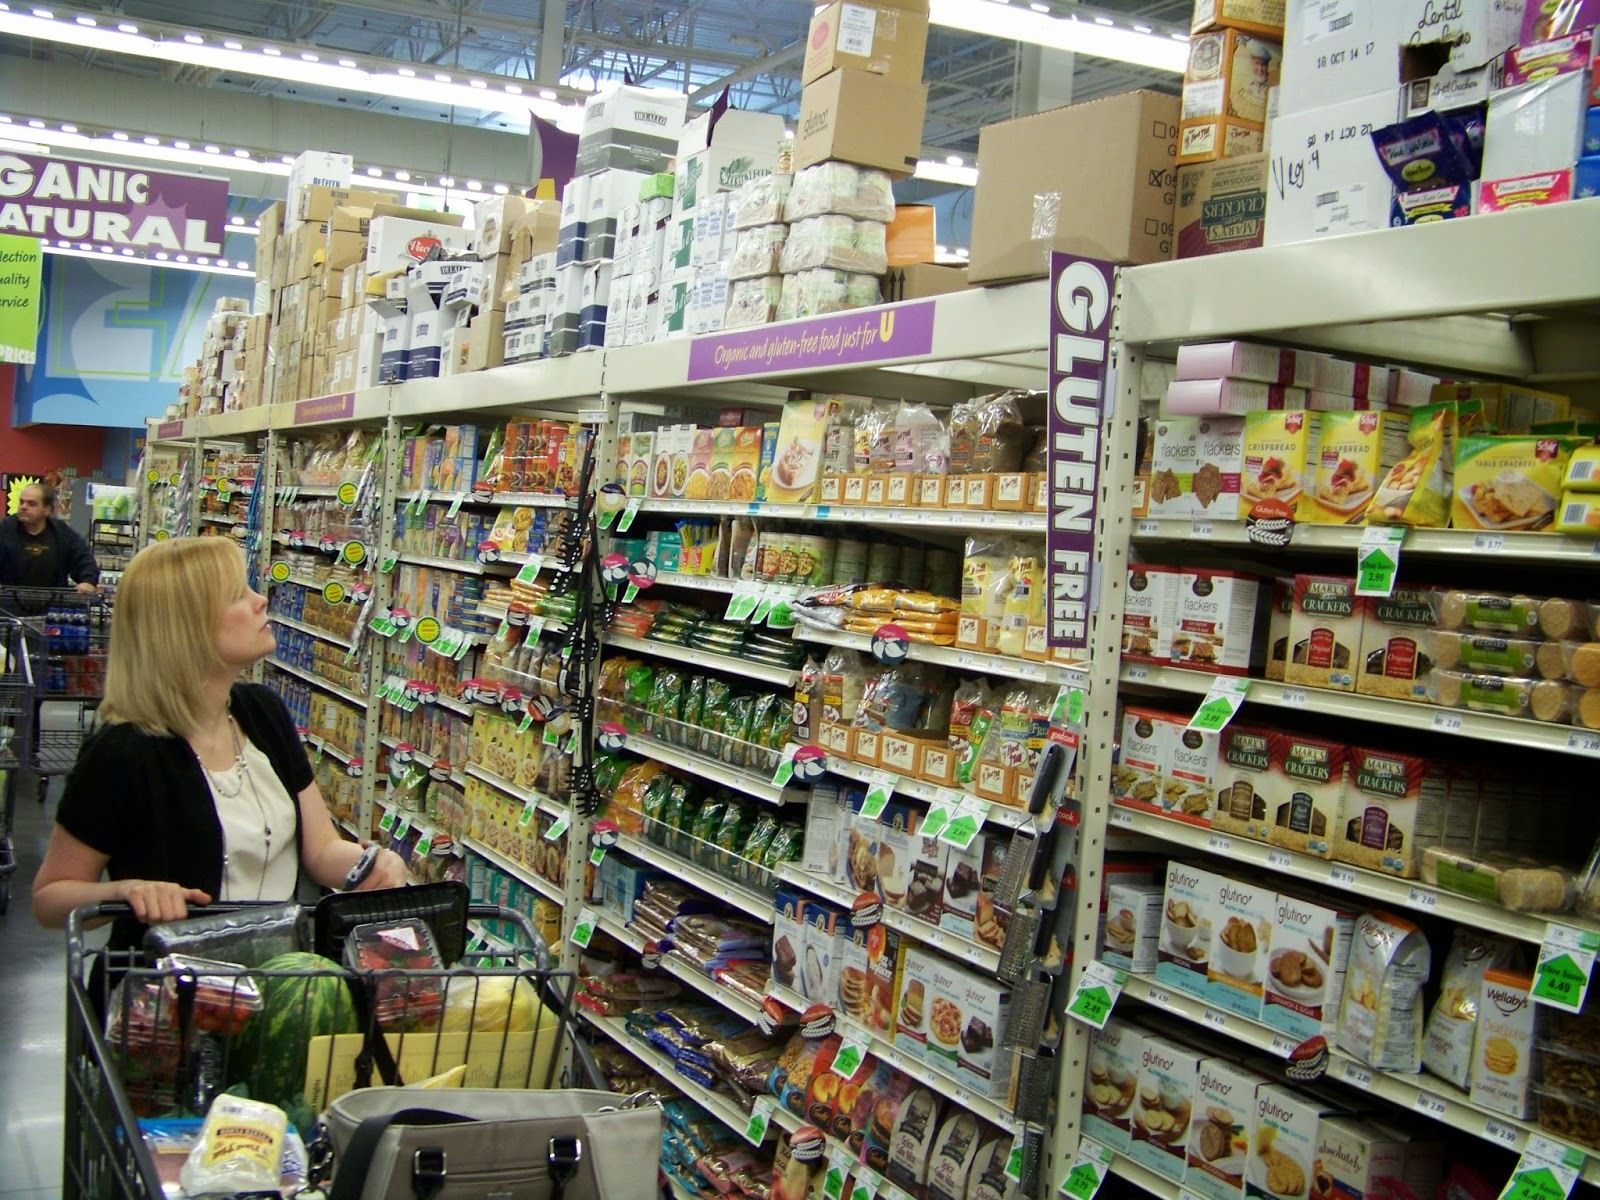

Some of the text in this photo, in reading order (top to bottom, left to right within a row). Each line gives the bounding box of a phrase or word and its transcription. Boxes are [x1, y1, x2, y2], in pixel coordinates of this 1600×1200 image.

[1317, 41, 1374, 69] 18 OCT 14 17
[1339, 125, 1356, 139] OCT
[1204, 196, 1265, 218] CRACKERS
[1211, 222, 1253, 238] MARY'S
[714, 310, 895, 370] Organic and gluten-free food just for U
[1054, 261, 1109, 532] GLUTEN
[1161, 444, 1196, 457] flackers
[1203, 440, 1241, 456] flackers
[1247, 443, 1296, 451] CRISPBREAD
[1321, 445, 1370, 453] CRISPBREAD
[1255, 504, 1275, 514] Gluten
[1368, 572, 1385, 582] 2.99
[1053, 549, 1090, 641] FREE
[1310, 583, 1348, 596] MARY'S
[1184, 597, 1219, 613] flackers
[1302, 599, 1351, 613] CRACKERS
[1128, 737, 1158, 756] flackers
[1174, 748, 1209, 768] flackers
[1227, 750, 1268, 769] CRACKERS
[1285, 760, 1329, 780] CRACKERS
[1357, 773, 1407, 795] CRACKERS
[1169, 868, 1198, 889] glutino
[1220, 883, 1251, 905] glutino
[1278, 902, 1310, 925] glutino
[1547, 980, 1571, 994] 4.49
[1487, 988, 1529, 1009] Wellaby's
[1142, 1049, 1173, 1070] glutino
[1200, 1072, 1231, 1096] glutino
[1258, 1098, 1293, 1122] glutino
